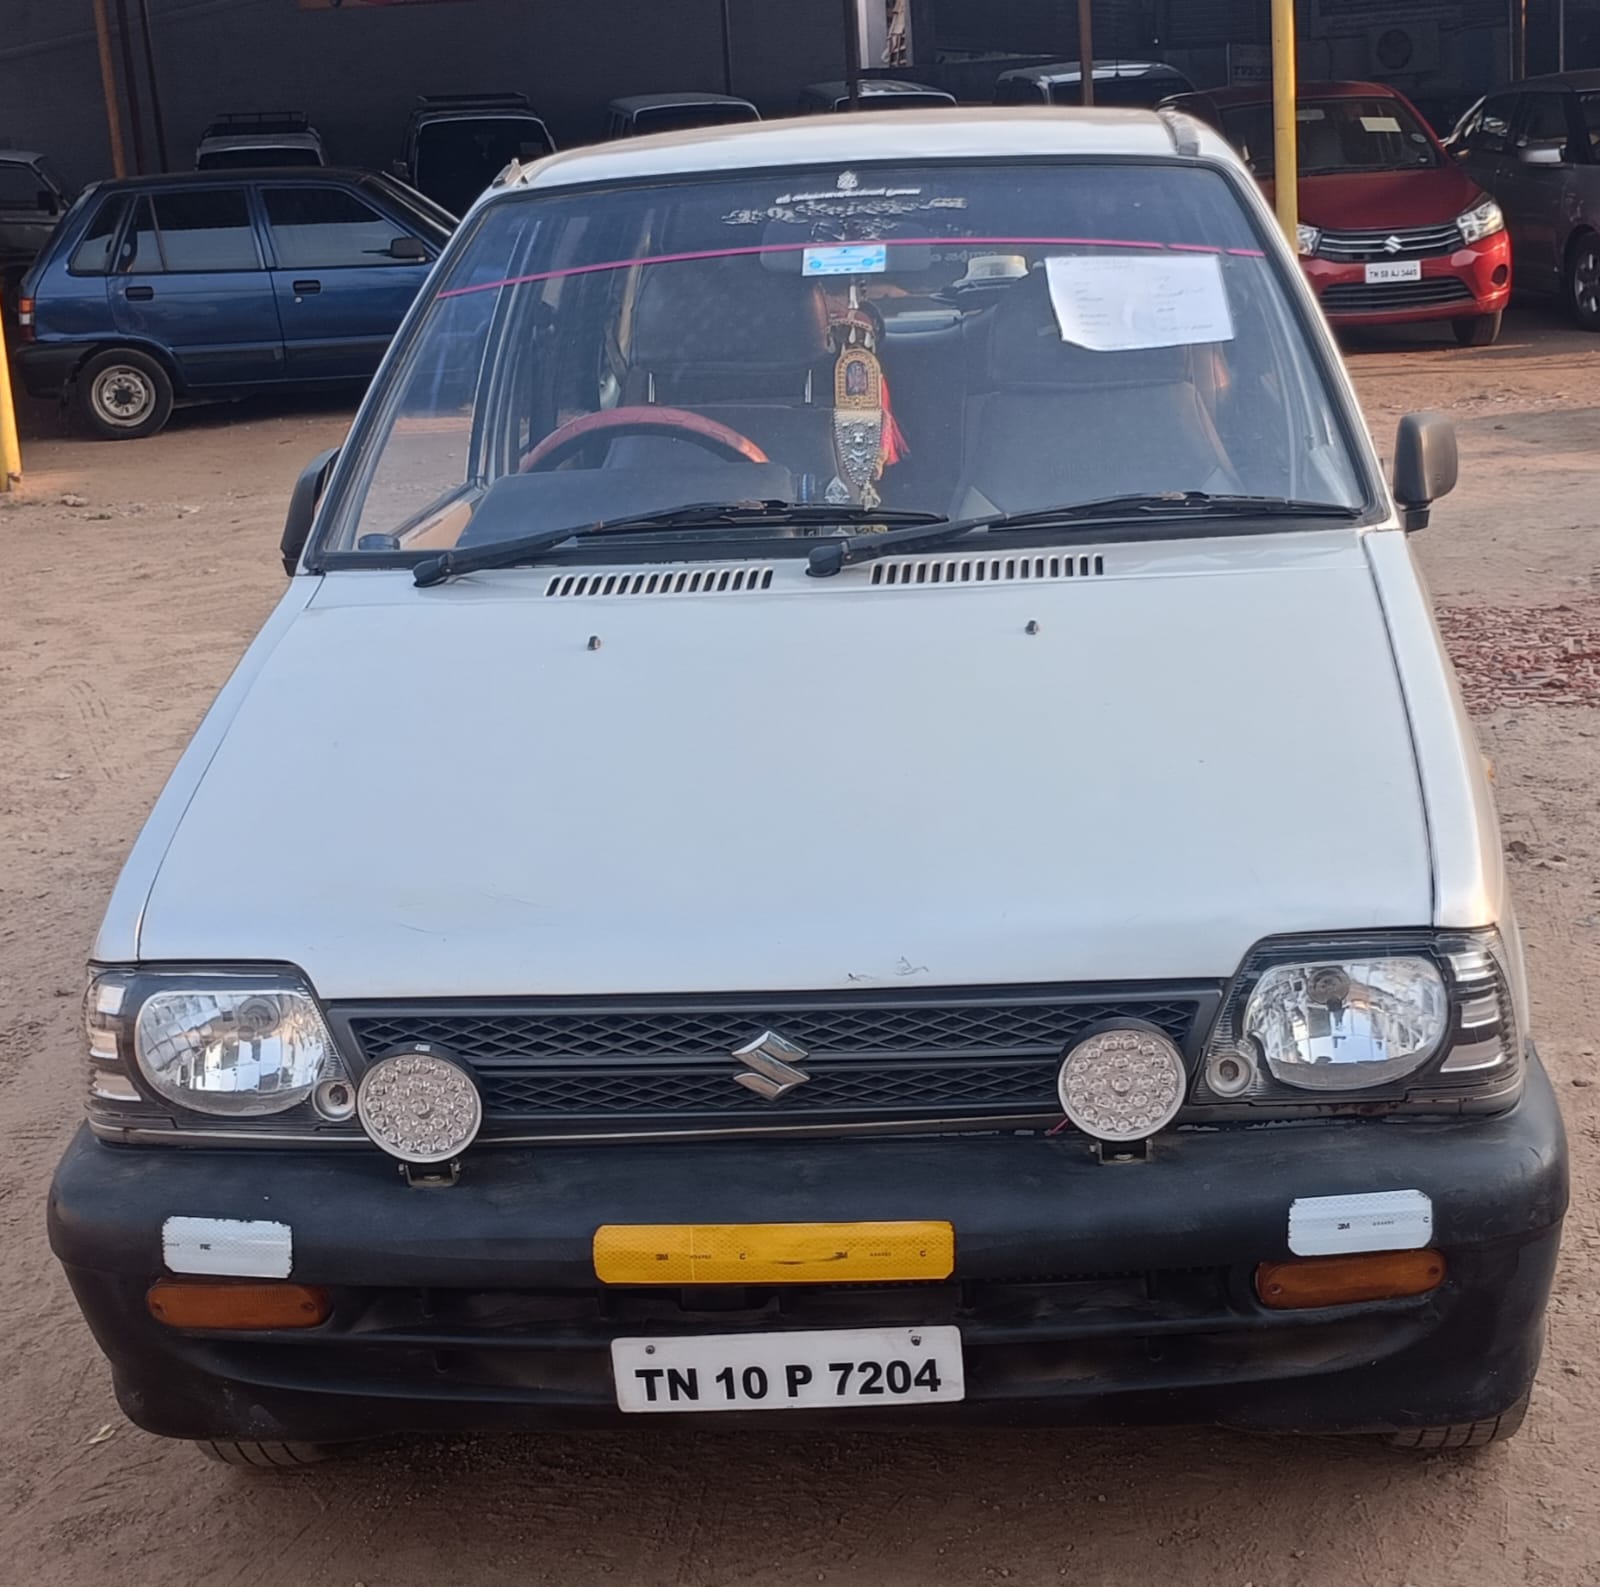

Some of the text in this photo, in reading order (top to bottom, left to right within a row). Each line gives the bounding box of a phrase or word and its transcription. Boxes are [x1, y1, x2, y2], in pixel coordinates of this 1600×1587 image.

[1337, 1222, 1350, 1230] 3M
[635, 1358, 942, 1402] TN 10 P 7204
